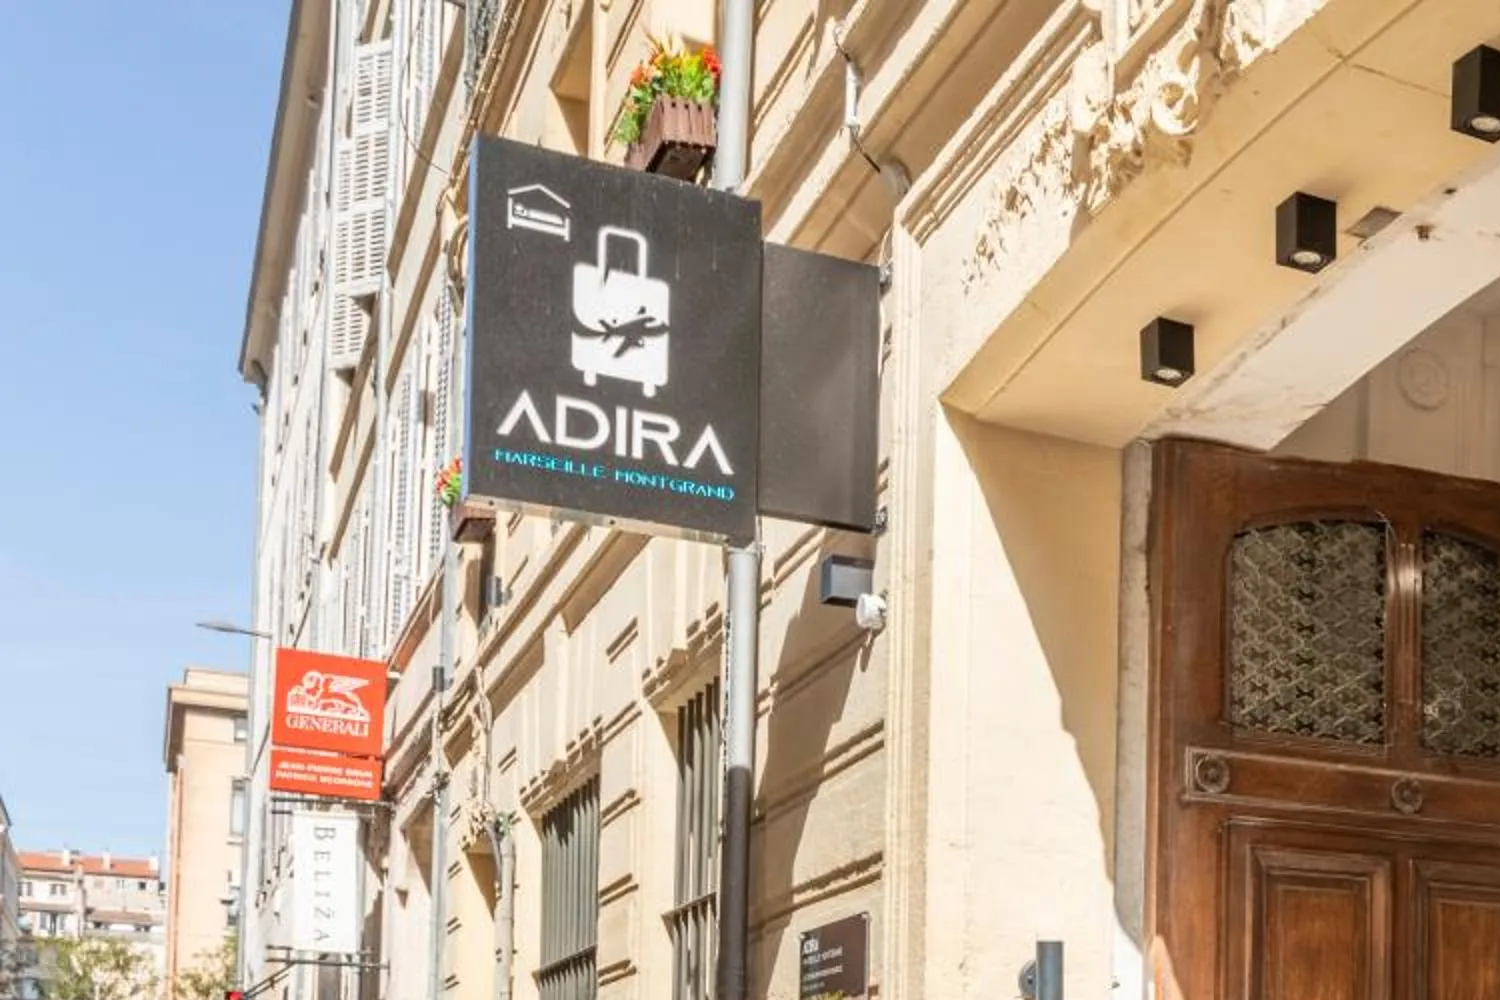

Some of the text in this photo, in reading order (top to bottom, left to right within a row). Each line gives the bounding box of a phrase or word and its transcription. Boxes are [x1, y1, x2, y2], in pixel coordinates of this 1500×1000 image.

[497, 389, 734, 476] ADIRA
[495, 448, 736, 502] MARSEILLE MONTGRAND
[286, 714, 369, 738] GENERALI
